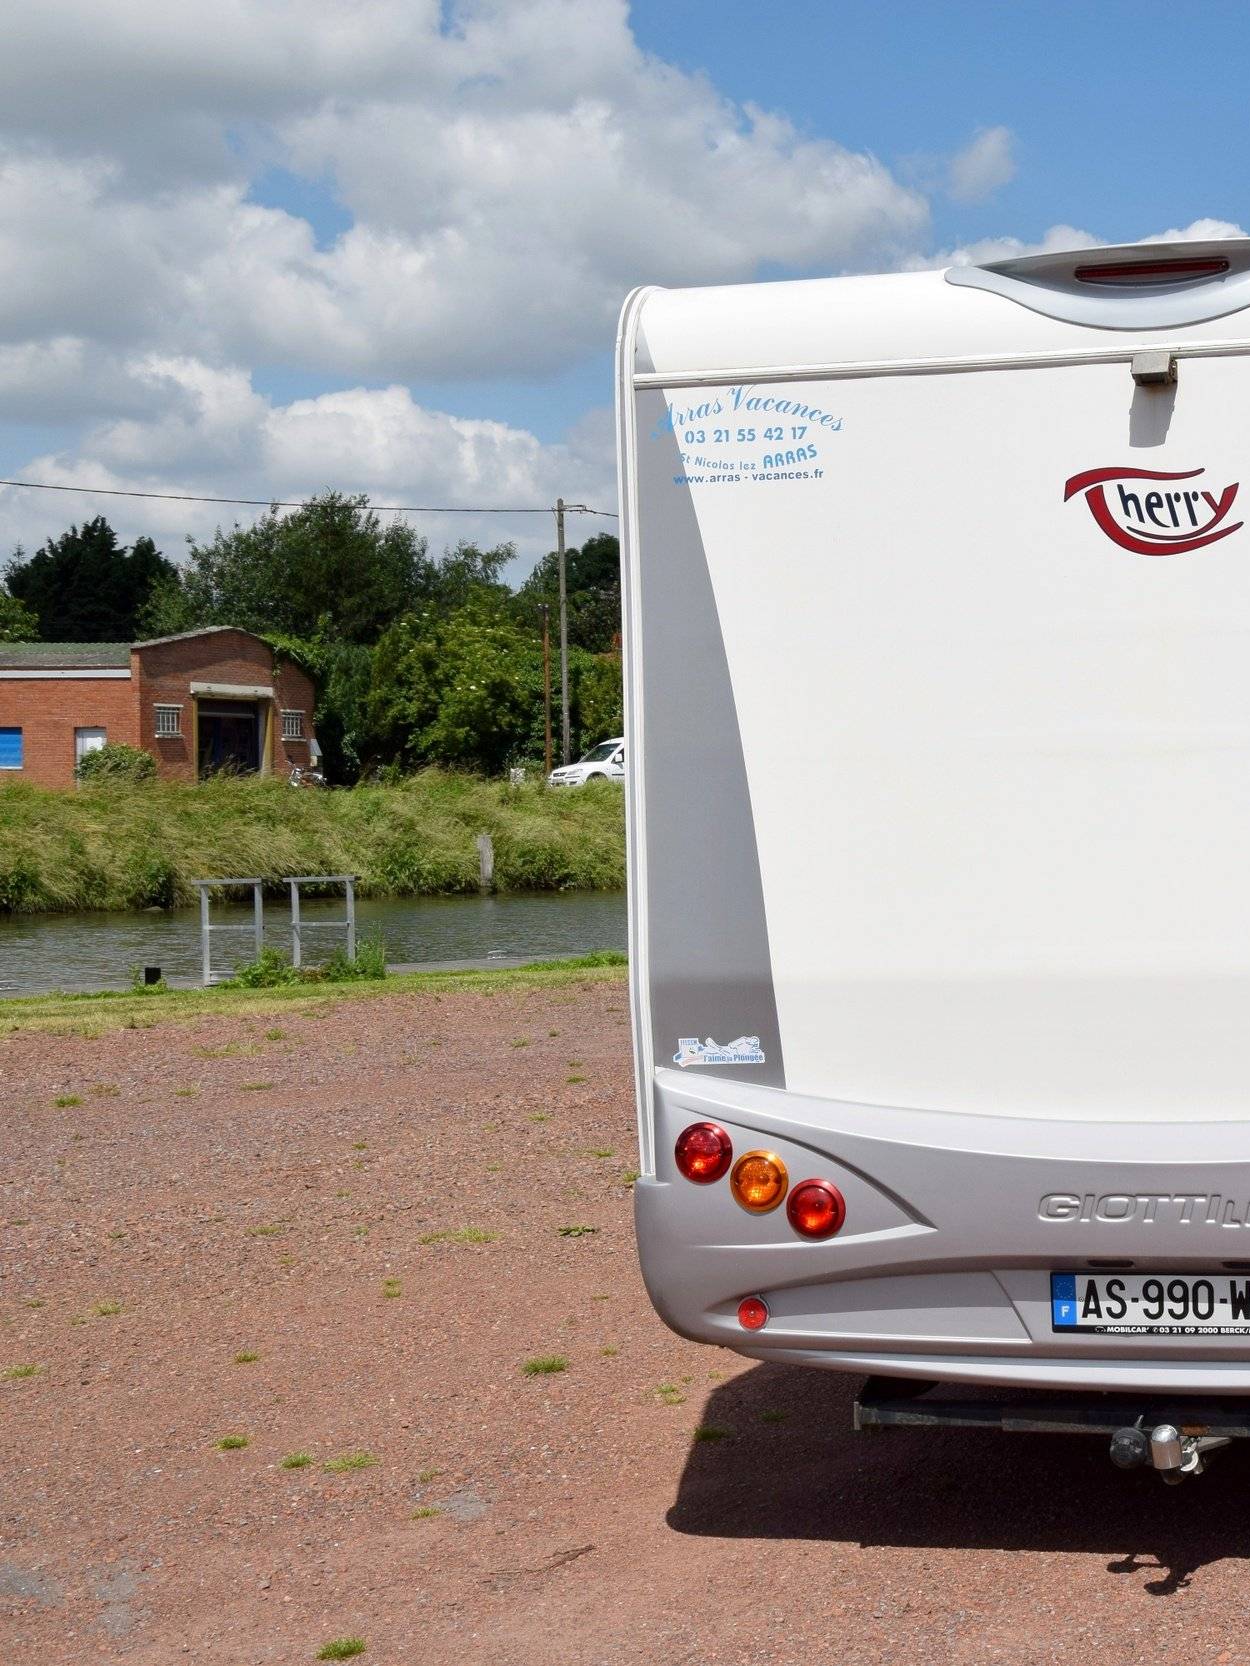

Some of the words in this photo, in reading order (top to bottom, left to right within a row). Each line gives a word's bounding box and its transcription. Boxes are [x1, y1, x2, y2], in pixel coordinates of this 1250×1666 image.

[727, 384, 845, 431] Vacances
[684, 430, 706, 443] 03
[713, 429, 730, 443] 21
[736, 428, 756, 442] 55
[763, 427, 784, 440] 42
[791, 426, 808, 439] 17
[694, 456, 735, 470] Nicolas
[739, 461, 756, 470] lez
[763, 443, 817, 469] ARRAS
[1061, 1306, 1070, 1318] F
[1159, 1326, 1170, 1335] 03
[1172, 1326, 1182, 1335] 21
[1184, 1326, 1196, 1335] 09
[1198, 1327, 1219, 1335] 2000
